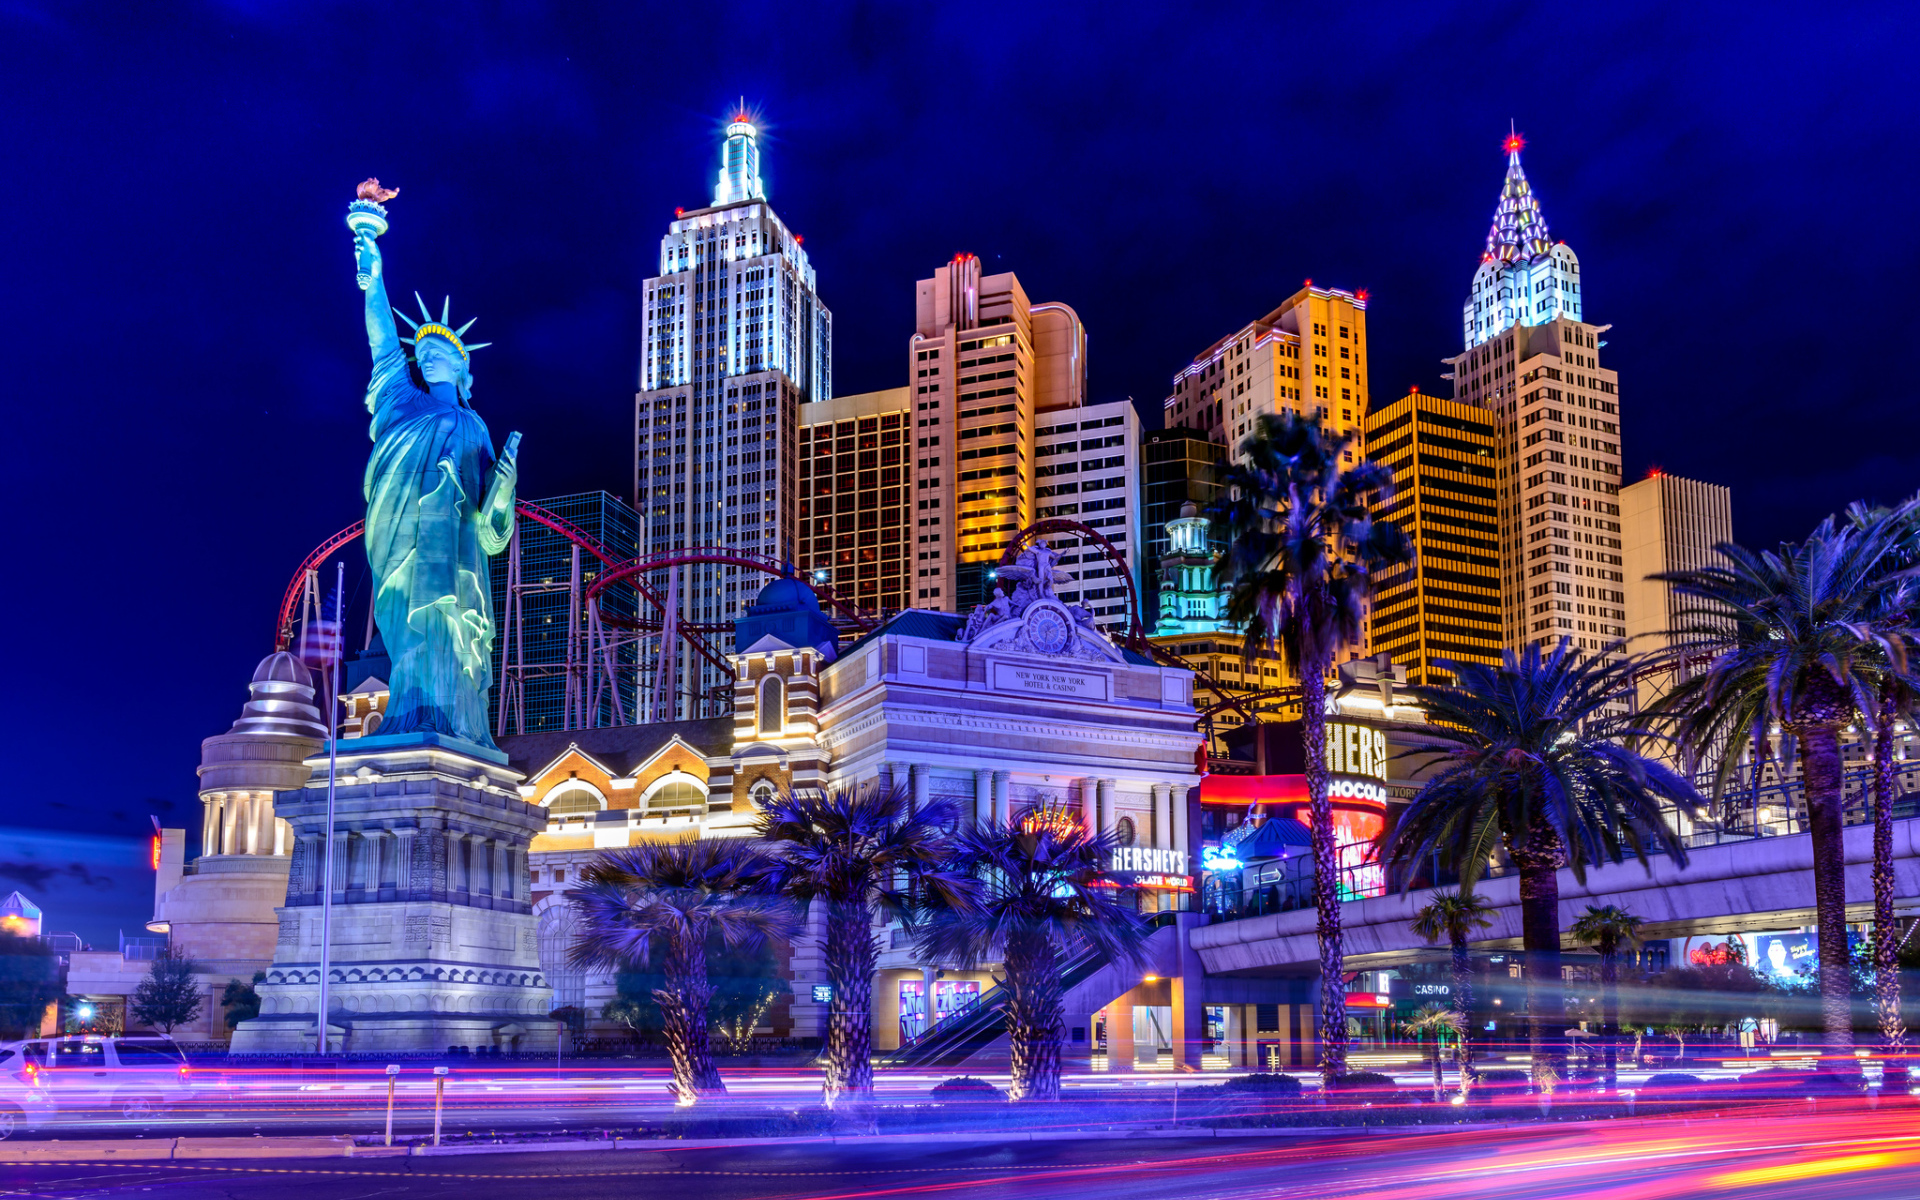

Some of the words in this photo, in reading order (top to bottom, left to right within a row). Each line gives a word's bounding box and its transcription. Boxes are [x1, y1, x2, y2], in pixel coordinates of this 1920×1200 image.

[1032, 673, 1050, 682] YORK
[1068, 677, 1085, 686] YORK
[1024, 681, 1044, 689] HOTEL
[1327, 780, 1387, 806] HOCOLA
[1165, 877, 1188, 887] WORLD
[1415, 985, 1449, 995] CASINO
